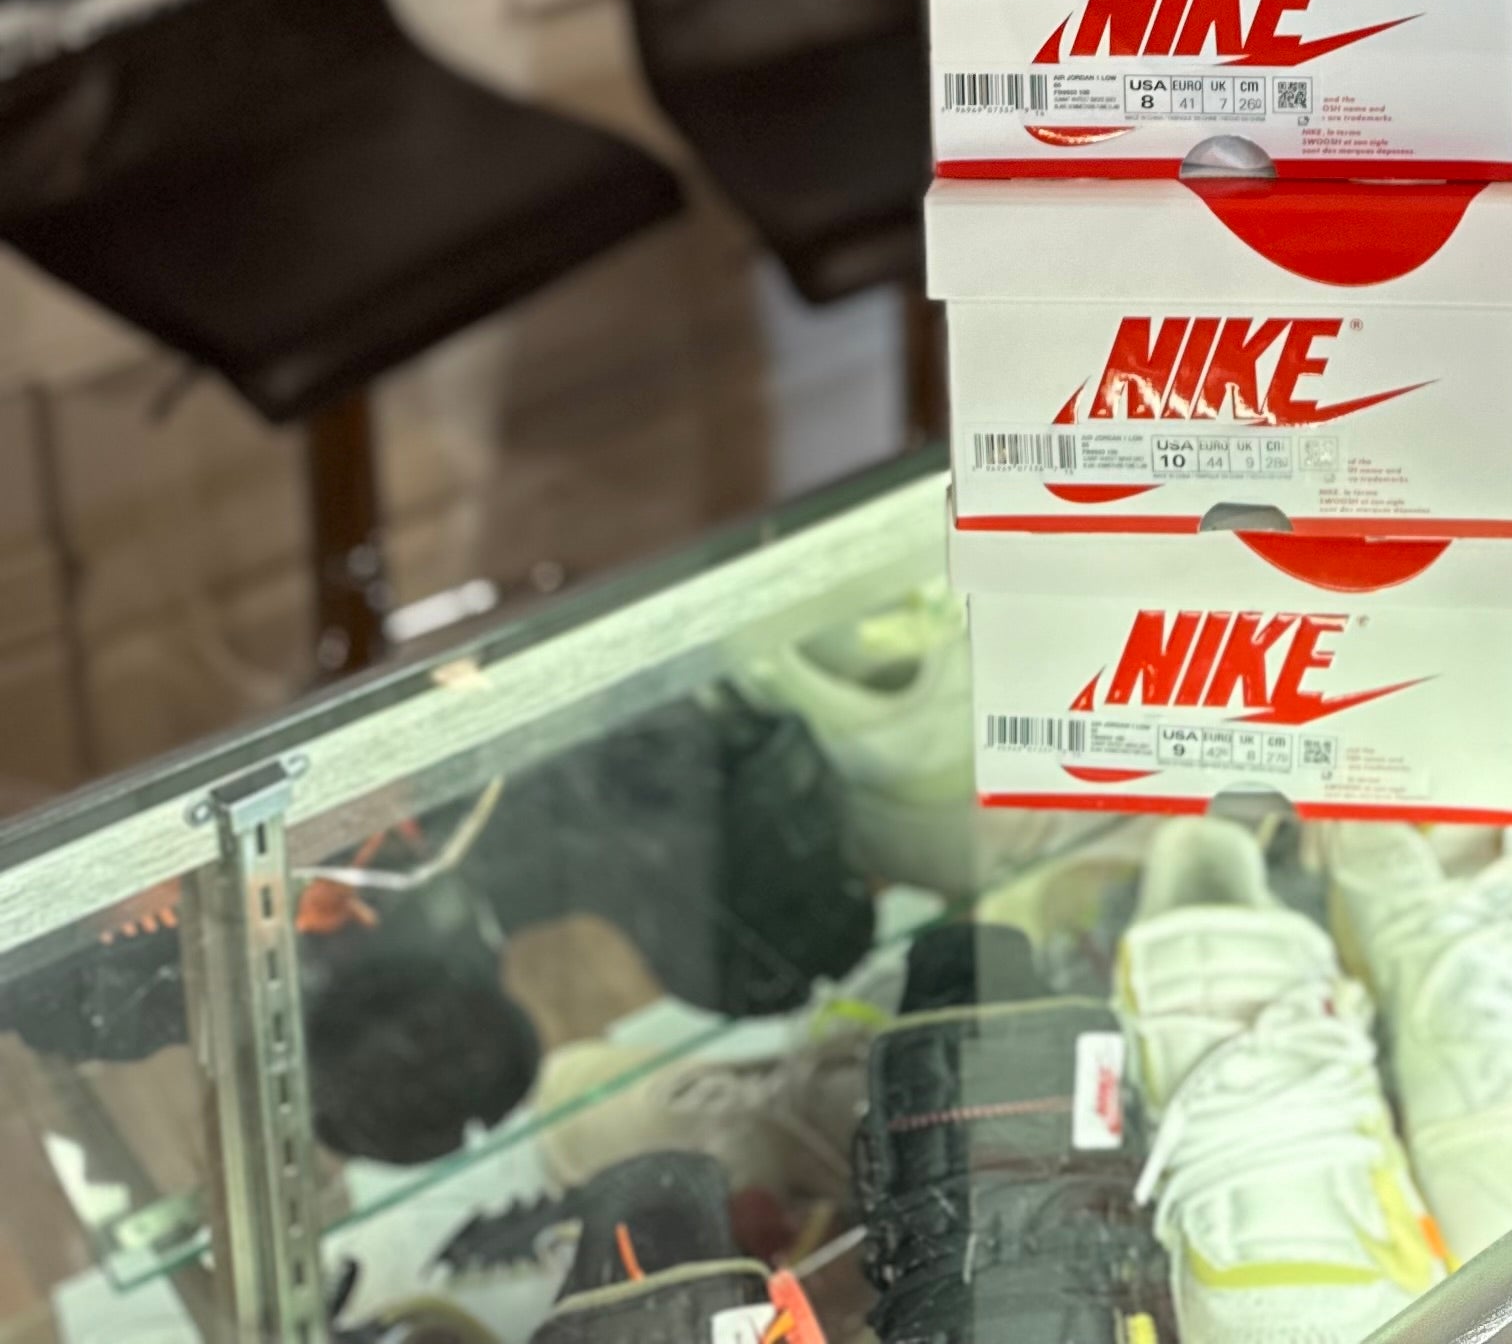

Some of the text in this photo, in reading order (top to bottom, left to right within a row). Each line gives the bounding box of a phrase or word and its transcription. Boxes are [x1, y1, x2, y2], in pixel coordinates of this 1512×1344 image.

[1130, 80, 1258, 92] USA EURO UK cm
[1141, 94, 1154, 109] 8
[1180, 99, 1194, 109] 41
[1220, 99, 1227, 109] 7
[1089, 316, 1343, 420] NIKE
[1157, 440, 1193, 451] USA
[1160, 455, 1185, 468] 10
[1105, 609, 1350, 708] NIKE
[1163, 730, 1198, 741] USA
